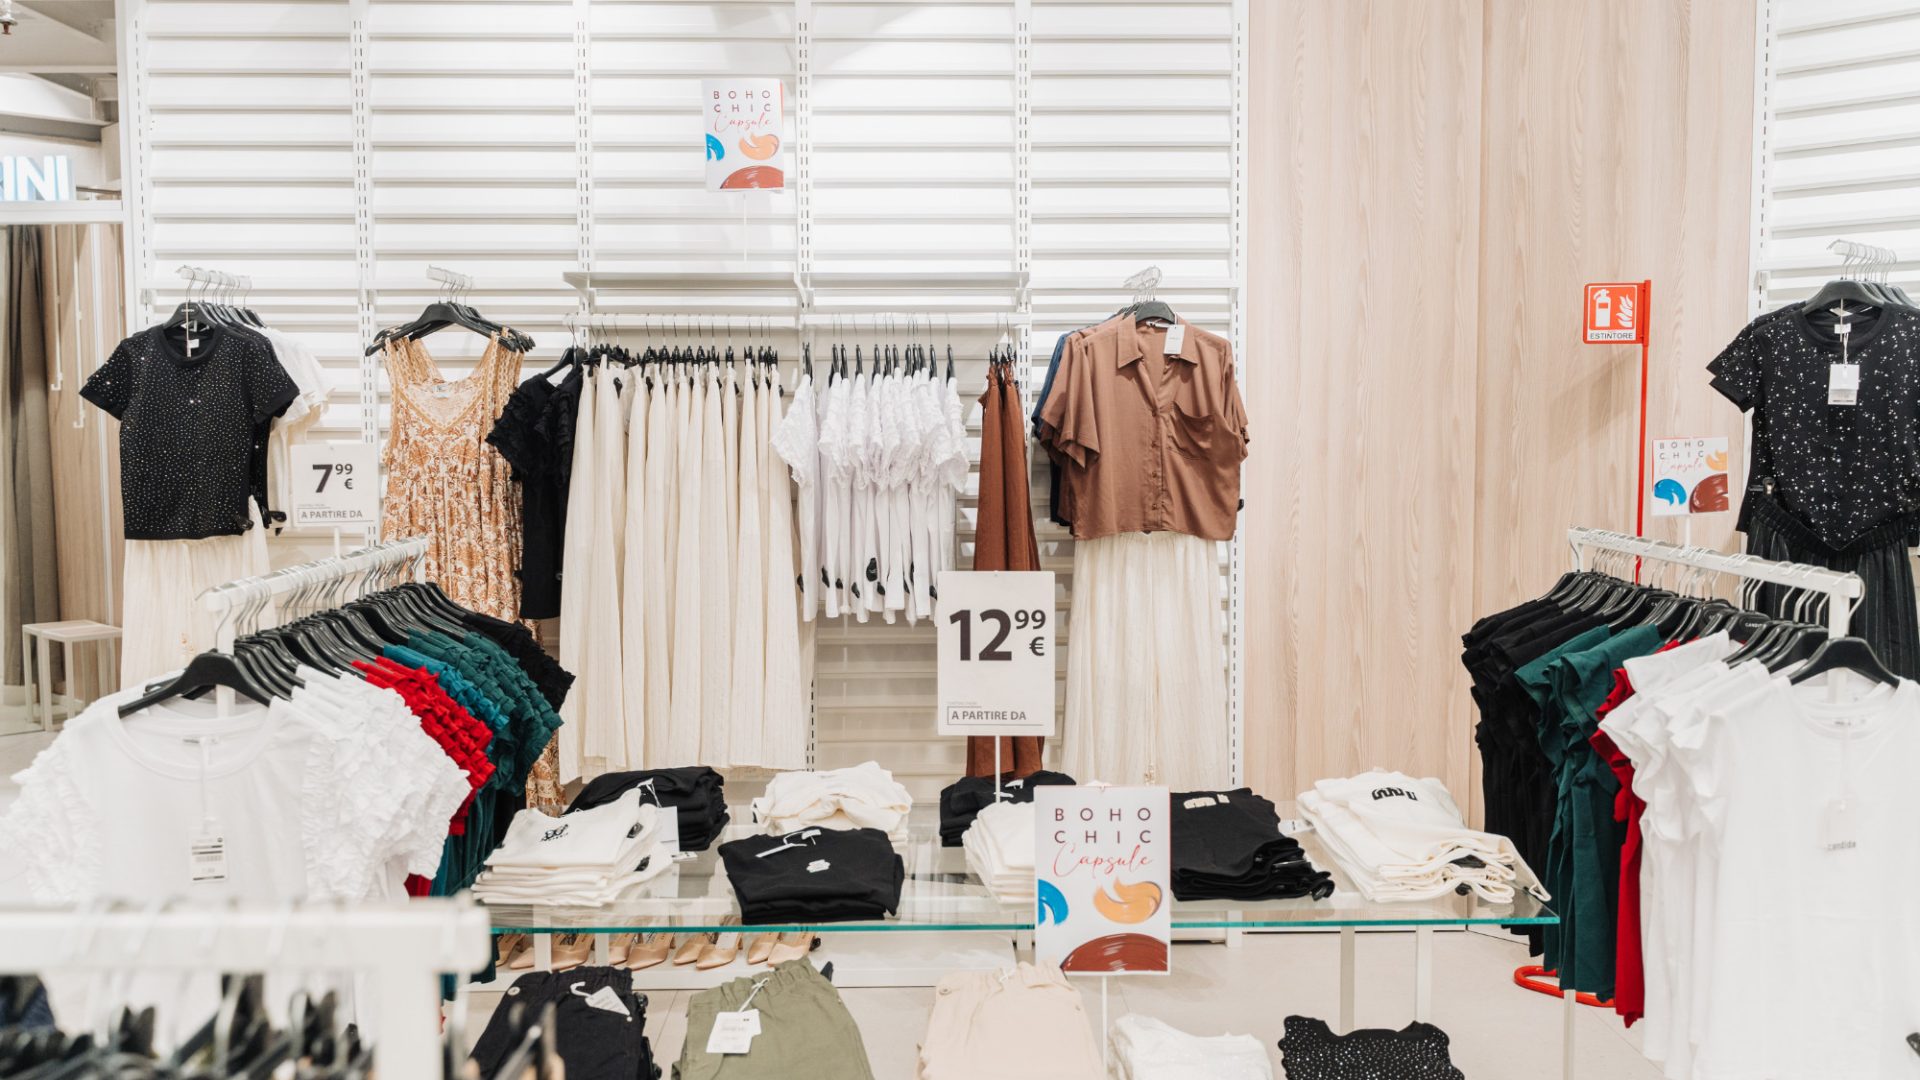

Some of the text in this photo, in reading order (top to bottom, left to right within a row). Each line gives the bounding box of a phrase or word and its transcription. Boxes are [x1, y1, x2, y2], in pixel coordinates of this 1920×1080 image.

[713, 90, 771, 100] BOHO
[713, 103, 771, 113] CHIC
[0, 155, 69, 201] INI
[1590, 332, 1633, 340] ESTINTORE
[1659, 440, 1704, 450] BOHO
[1659, 450, 1704, 460] CHIC
[301, 510, 363, 519] A PARTIRE DA
[951, 710, 1027, 720] A PARTIRE DA
[1054, 807, 1151, 821] BOHO
[1054, 830, 1151, 844] CHIC
[1053, 843, 1153, 879] Capsule
